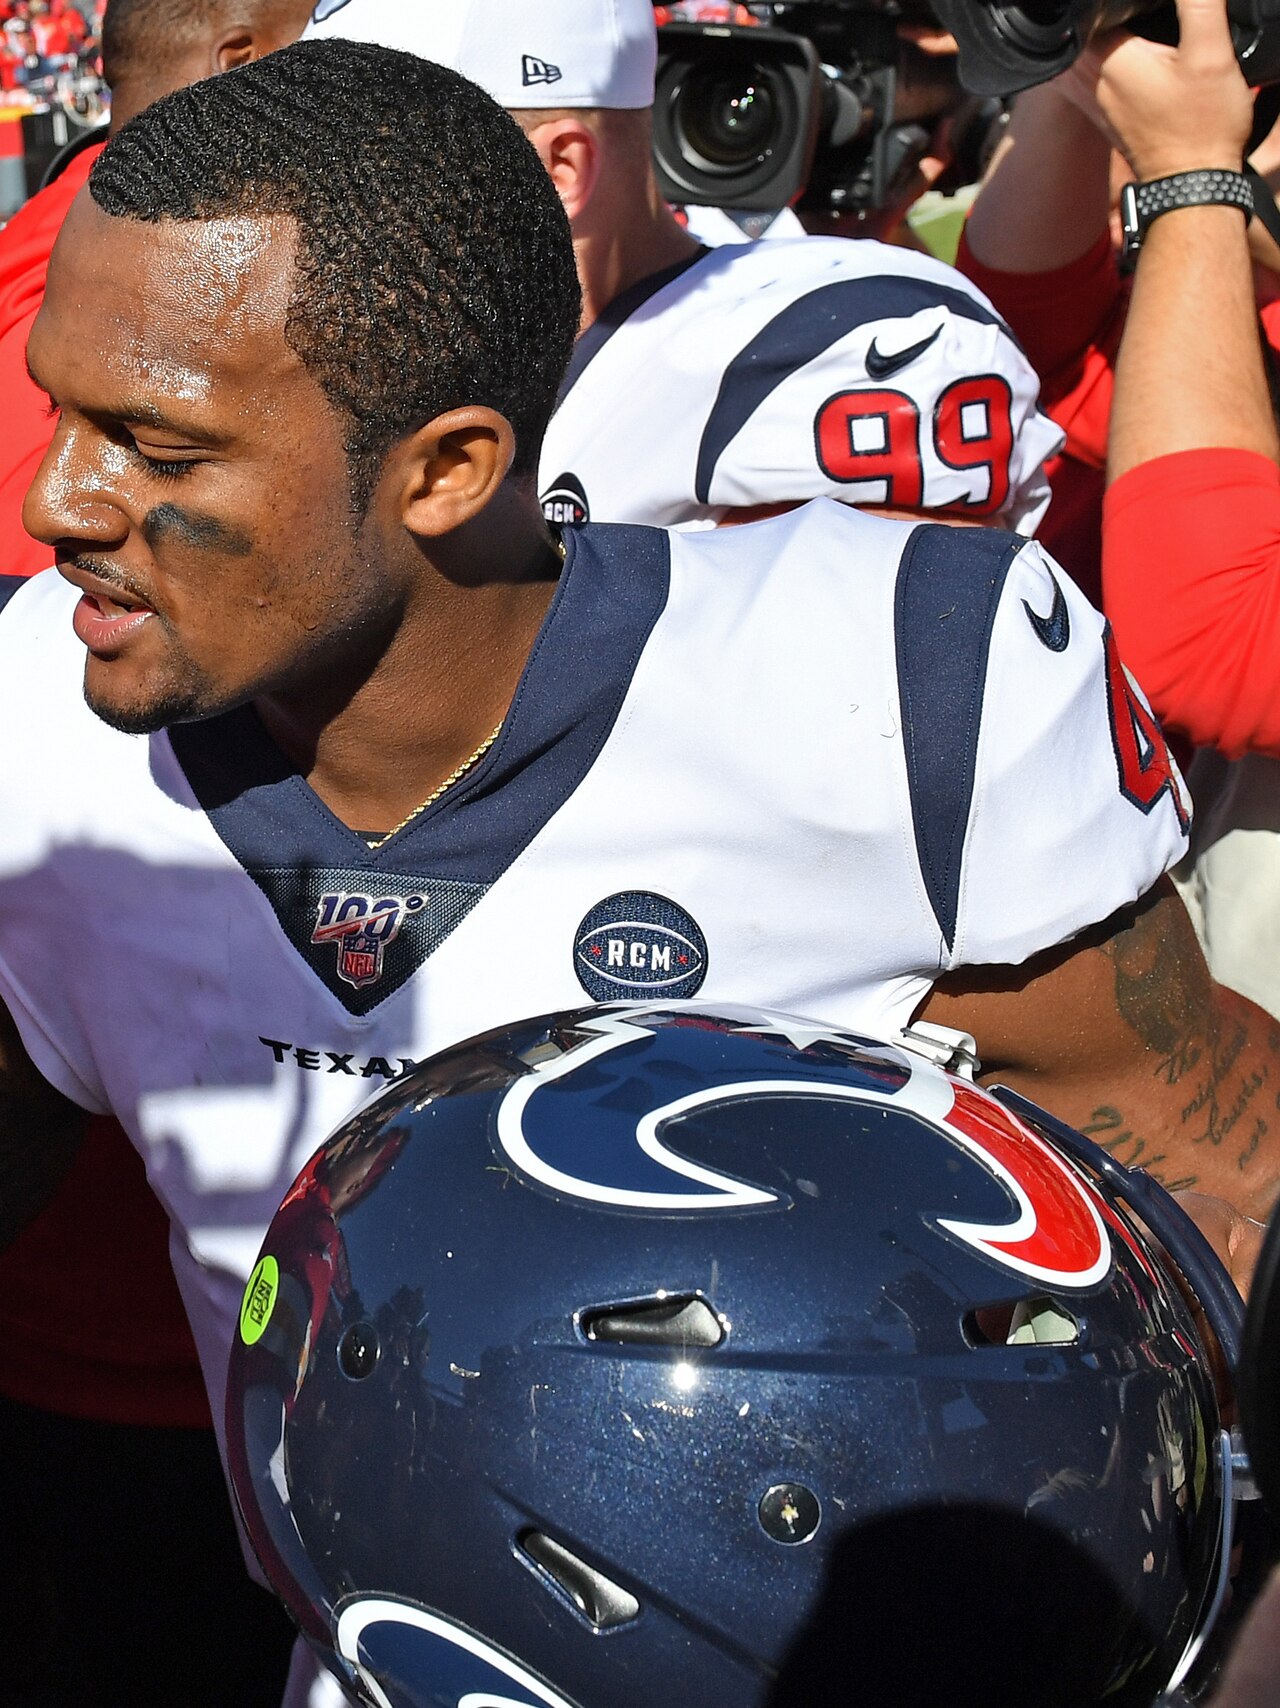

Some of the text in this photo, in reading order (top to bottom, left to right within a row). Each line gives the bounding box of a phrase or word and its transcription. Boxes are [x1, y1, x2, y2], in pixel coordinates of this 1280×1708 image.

[814, 373, 1013, 516] 99
[344, 952, 376, 978] NFL
[608, 940, 671, 971] RCM
